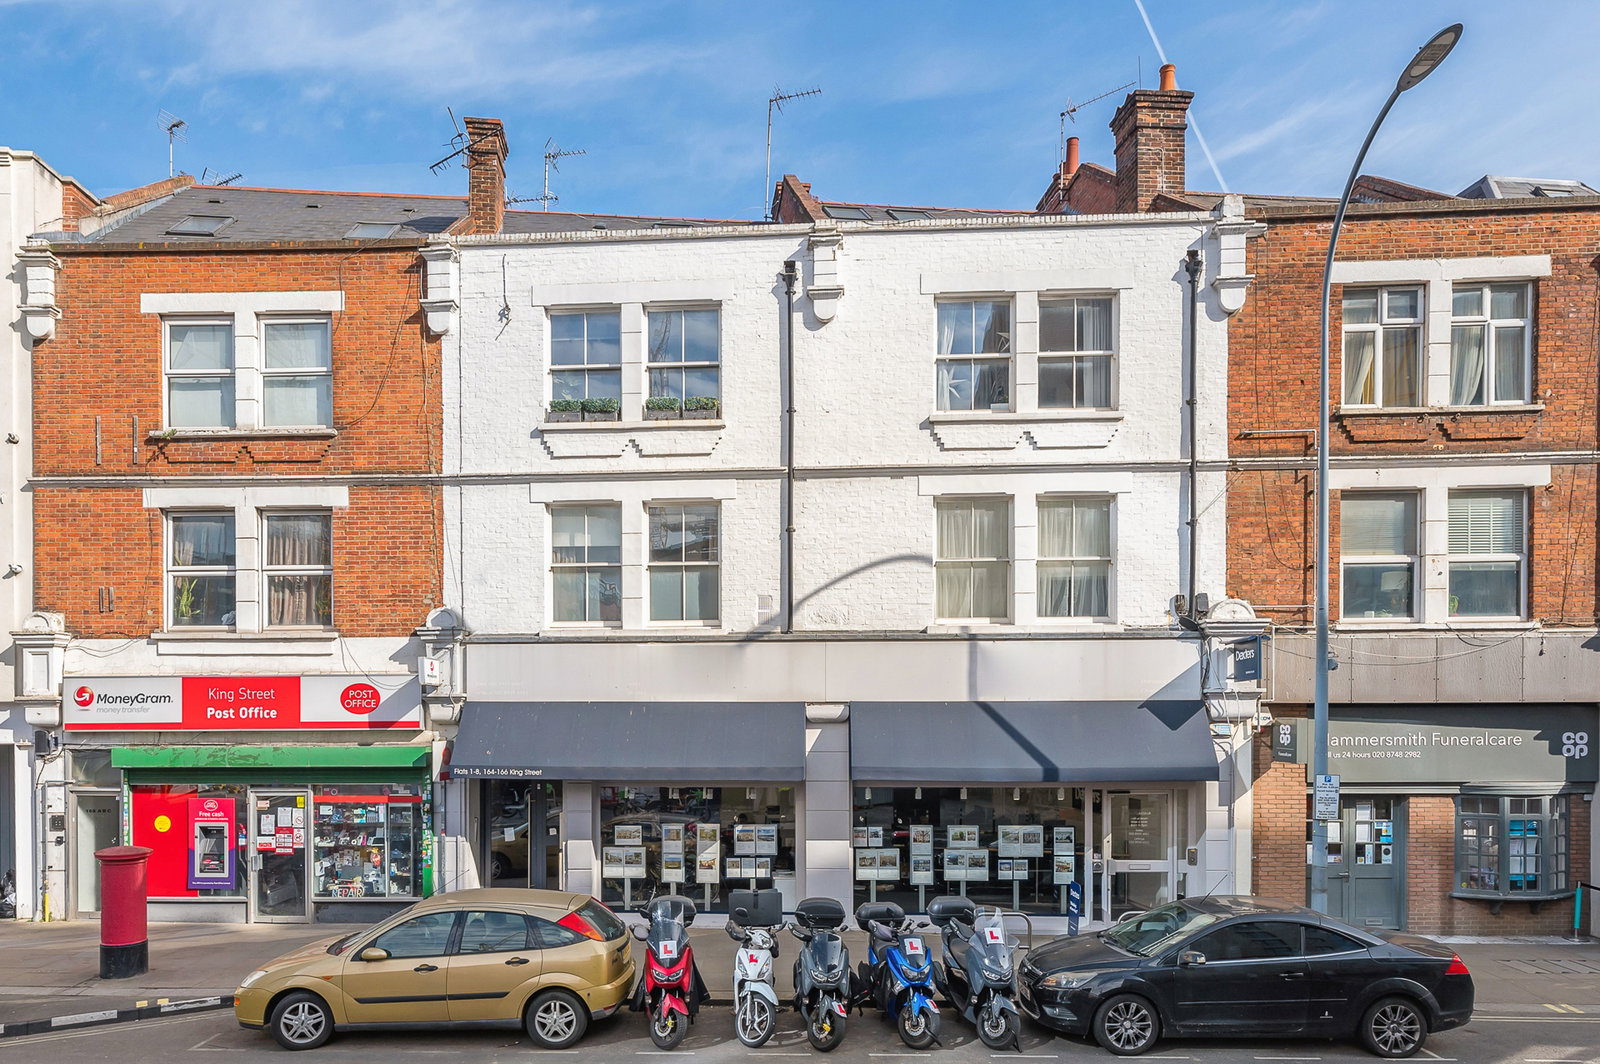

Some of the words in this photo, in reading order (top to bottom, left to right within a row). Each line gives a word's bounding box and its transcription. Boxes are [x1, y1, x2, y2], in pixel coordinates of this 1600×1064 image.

[208, 687, 235, 702] King
[238, 687, 275, 700] Street
[348, 689, 374, 699] POST
[344, 699, 377, 708] OFFICE
[96, 706, 120, 715] money
[121, 705, 151, 713] transfer
[206, 706, 236, 719] Post
[239, 706, 278, 719] Office
[1328, 732, 1427, 746] ammersmith
[1431, 732, 1523, 746] Funeralcare
[470, 768, 481, 776] 1-8,
[483, 768, 508, 776] 164-166
[509, 768, 523, 777] King
[332, 887, 362, 898] REPAIR
[989, 930, 999, 940] L
[663, 944, 673, 954] L
[909, 941, 918, 951] L
[749, 954, 758, 963] L
[837, 1004, 846, 1013] L
